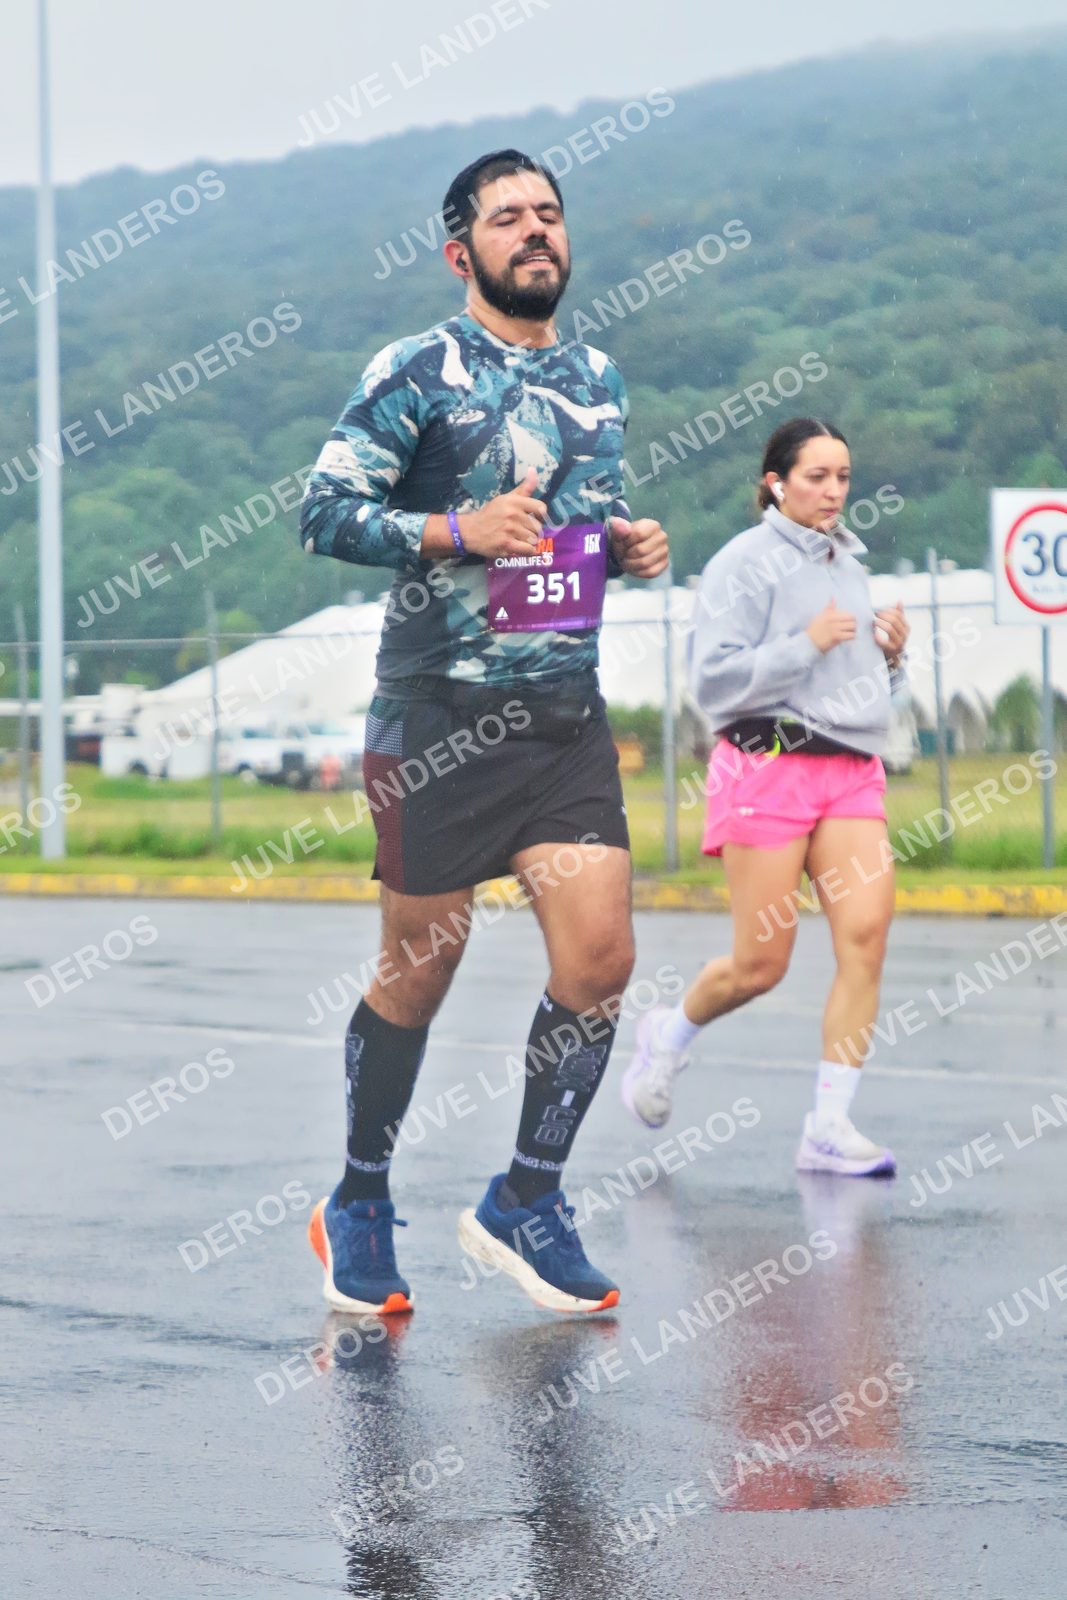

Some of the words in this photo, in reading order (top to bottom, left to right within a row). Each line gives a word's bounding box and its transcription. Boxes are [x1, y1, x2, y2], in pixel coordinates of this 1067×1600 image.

[584, 533, 601, 554] 15K
[495, 555, 541, 567] OMNILIFE
[526, 571, 580, 604] 351
